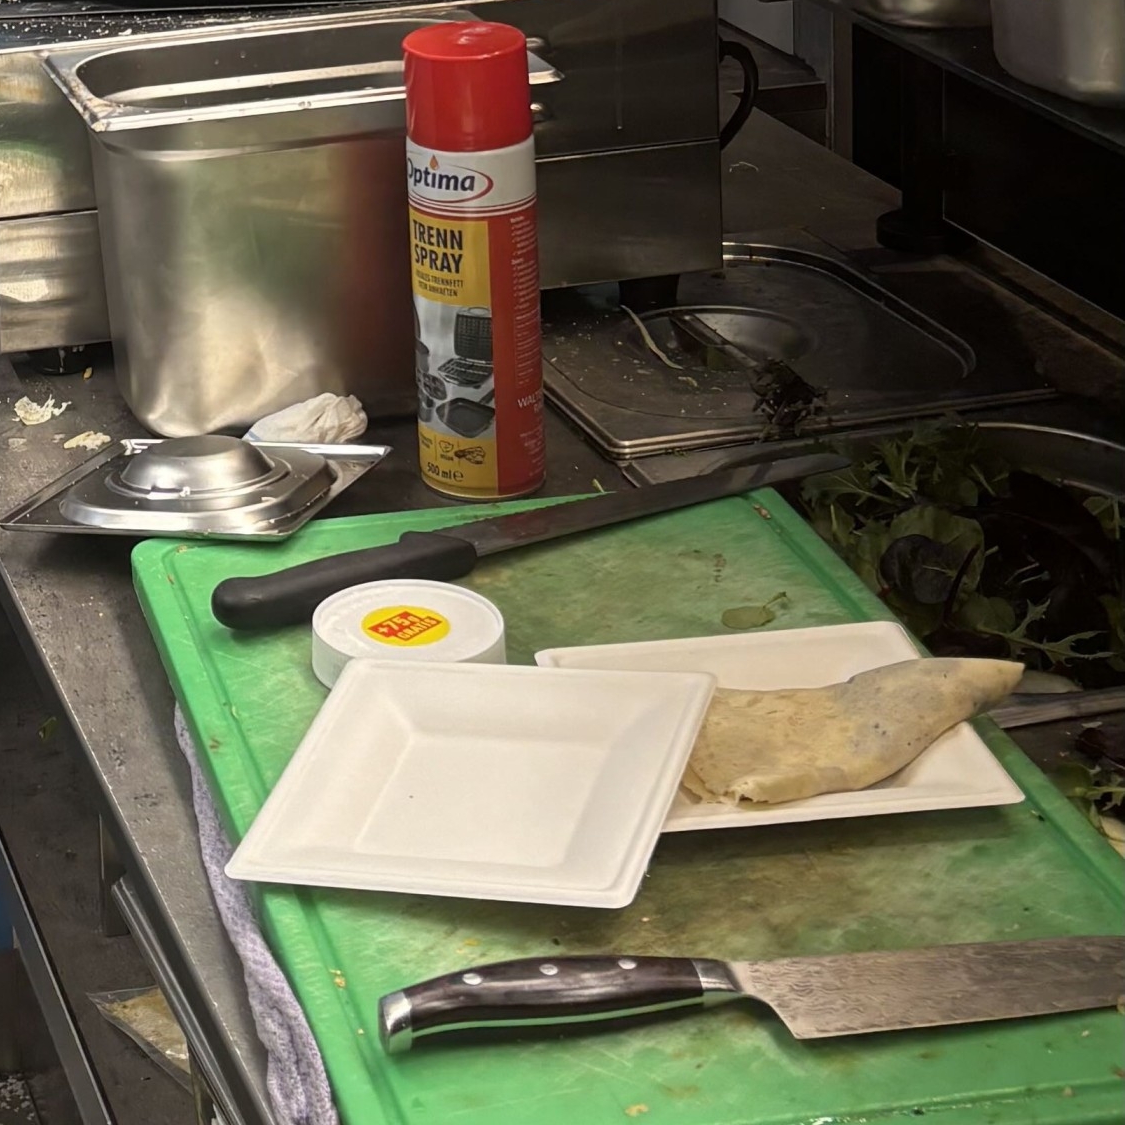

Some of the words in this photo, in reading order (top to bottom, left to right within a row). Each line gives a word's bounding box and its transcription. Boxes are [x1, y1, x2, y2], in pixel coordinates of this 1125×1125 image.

[413, 219, 463, 251] TRENN
[414, 244, 463, 274] SPRAY
[427, 461, 440, 476] 500
[441, 470, 452, 480] ml
[396, 618, 438, 639] GRATIS
